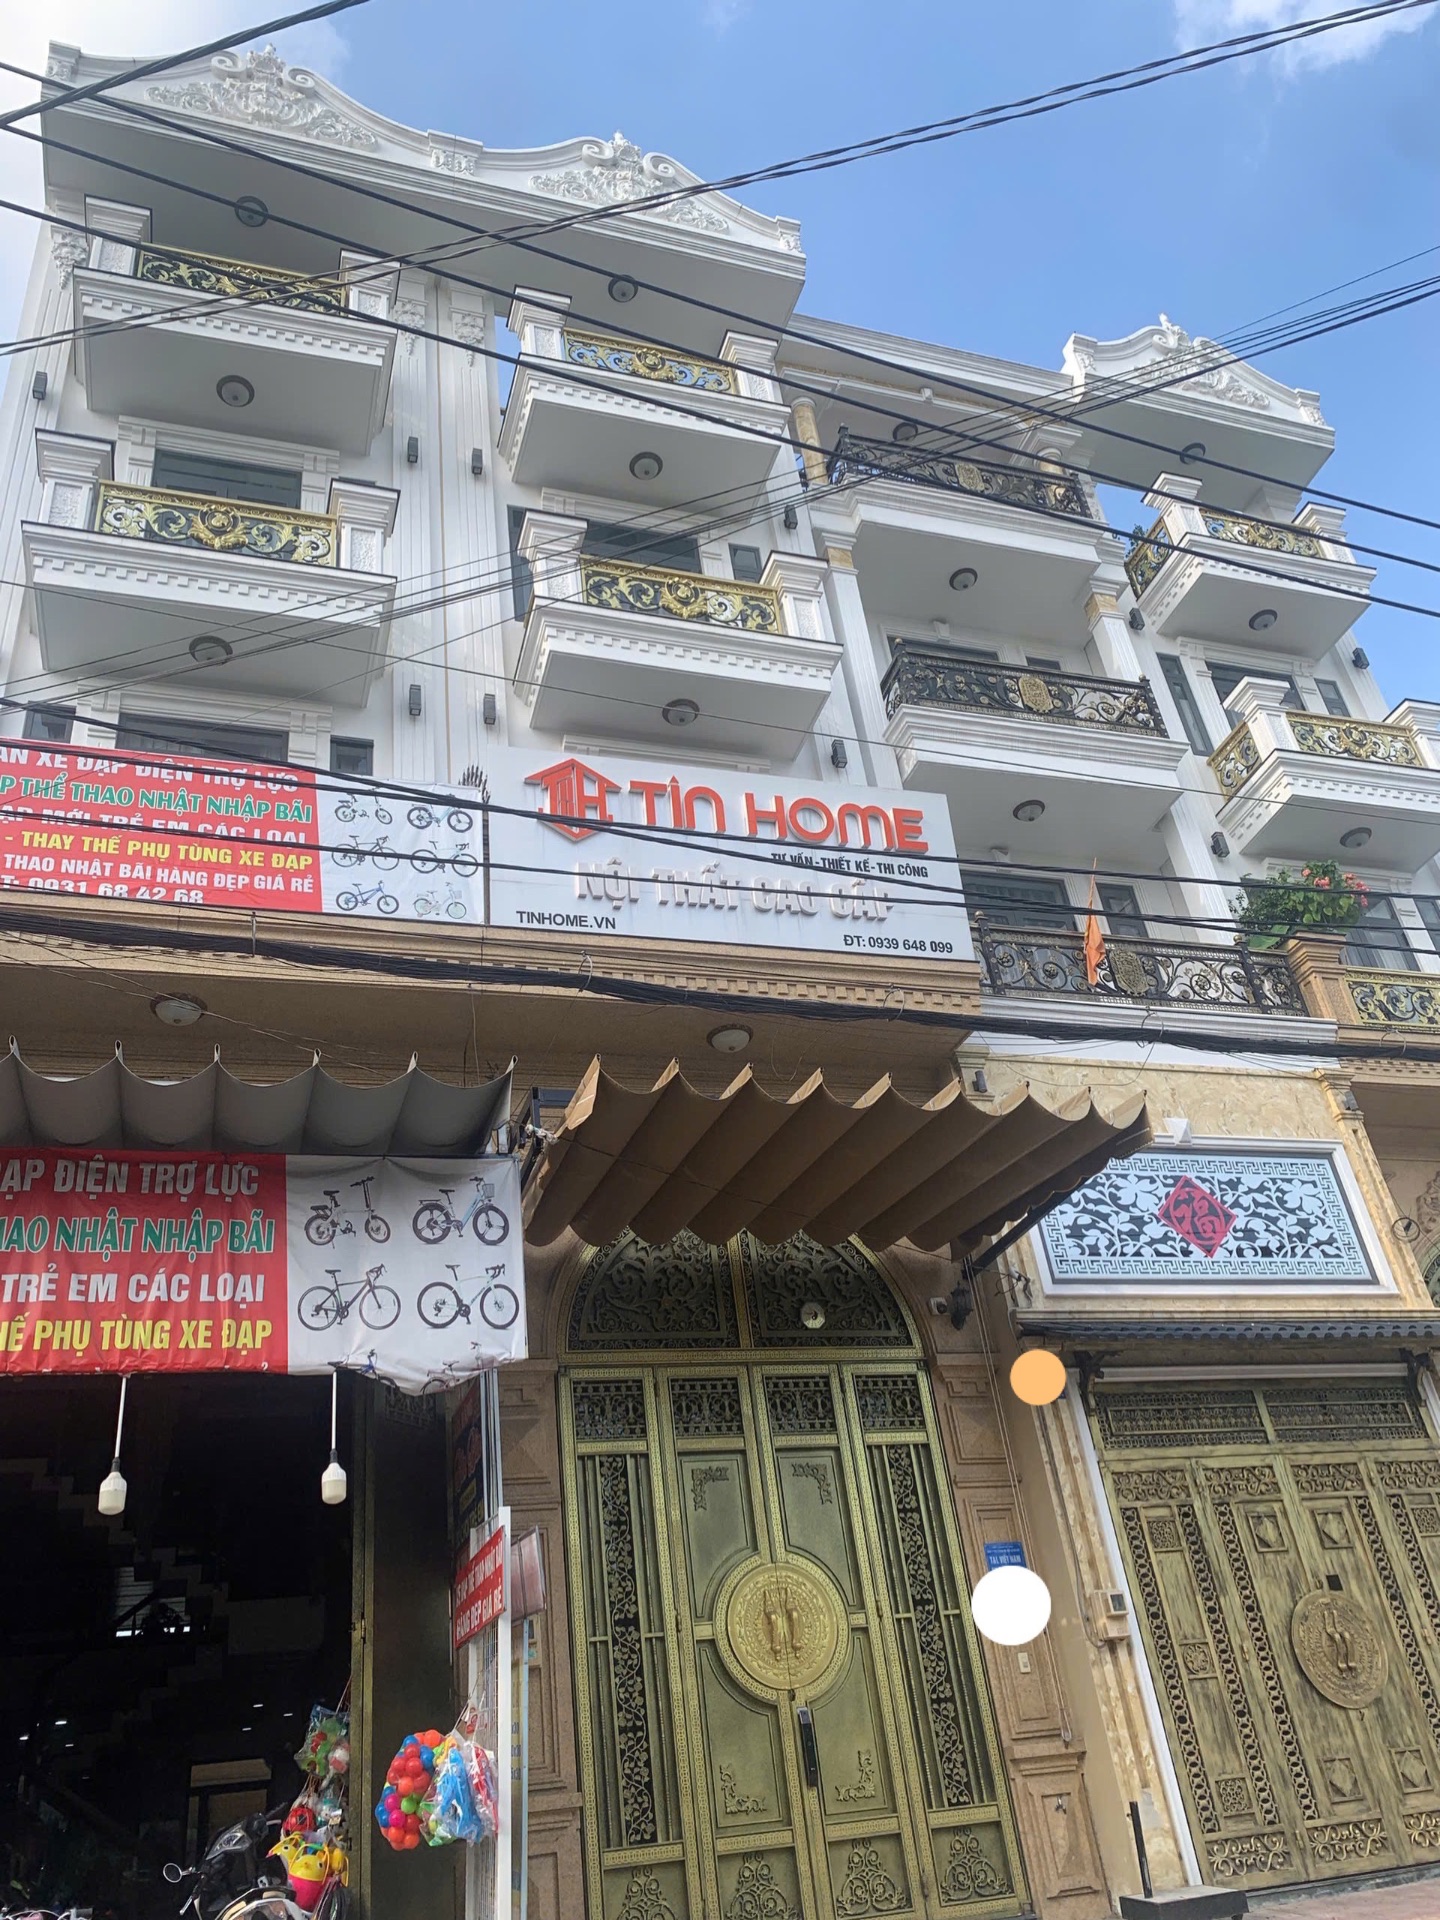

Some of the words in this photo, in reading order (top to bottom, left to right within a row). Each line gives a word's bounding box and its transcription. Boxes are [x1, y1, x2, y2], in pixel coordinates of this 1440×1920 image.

[36, 752, 68, 769] XE
[76, 756, 128, 777] ĐẠP
[134, 758, 193, 784] ĐIỆN
[200, 763, 247, 791] TRỢ
[254, 771, 299, 794] LỰC
[20, 772, 69, 800] THỂ
[71, 782, 135, 808] THAO
[138, 787, 203, 817] NHẬT
[206, 794, 271, 823] NHẬP
[275, 800, 313, 824] BÃI
[21, 831, 75, 851] THAY
[81, 835, 122, 855] THẾ
[127, 840, 171, 862] PHỤ
[177, 842, 232, 865] TÙNG
[238, 850, 265, 867] XE
[271, 853, 313, 872] ĐẠP
[897, 862, 929, 878] CÔNG
[4, 853, 55, 872] THAO
[60, 858, 114, 879] NHẬT
[118, 862, 153, 880] BÃI
[156, 866, 208, 887] HÀNG
[213, 872, 250, 892] ĐẸP
[253, 873, 285, 892] GIÁ
[290, 874, 314, 893] RẺ
[97, 883, 128, 899] 68
[135, 886, 167, 900] 42
[174, 888, 204, 904] 68
[576, 857, 640, 910] NỘI
[652, 860, 740, 911] THẤT
[751, 876, 818, 916] CAO
[516, 910, 616, 929] TINHOME.VN
[843, 934, 866, 947] ĐT:
[868, 936, 899, 950] 0939
[903, 939, 927, 952] 648
[930, 940, 953, 954] 099
[54, 1154, 129, 1199] ĐIỆN
[139, 1160, 198, 1202] TRỢ
[204, 1161, 259, 1202] LỰC
[54, 1206, 138, 1263] NHẬT
[141, 1207, 224, 1263] NHẬP
[227, 1208, 276, 1253] BÃI
[1, 1262, 59, 1303] TRẺ
[68, 1273, 118, 1303] EM
[128, 1267, 189, 1303] CÁC
[200, 1272, 265, 1309] LOẠI
[32, 1319, 92, 1357] PHỤ
[100, 1313, 171, 1351] TÙNG
[178, 1319, 214, 1350] XE
[221, 1318, 273, 1356] ĐẠP
